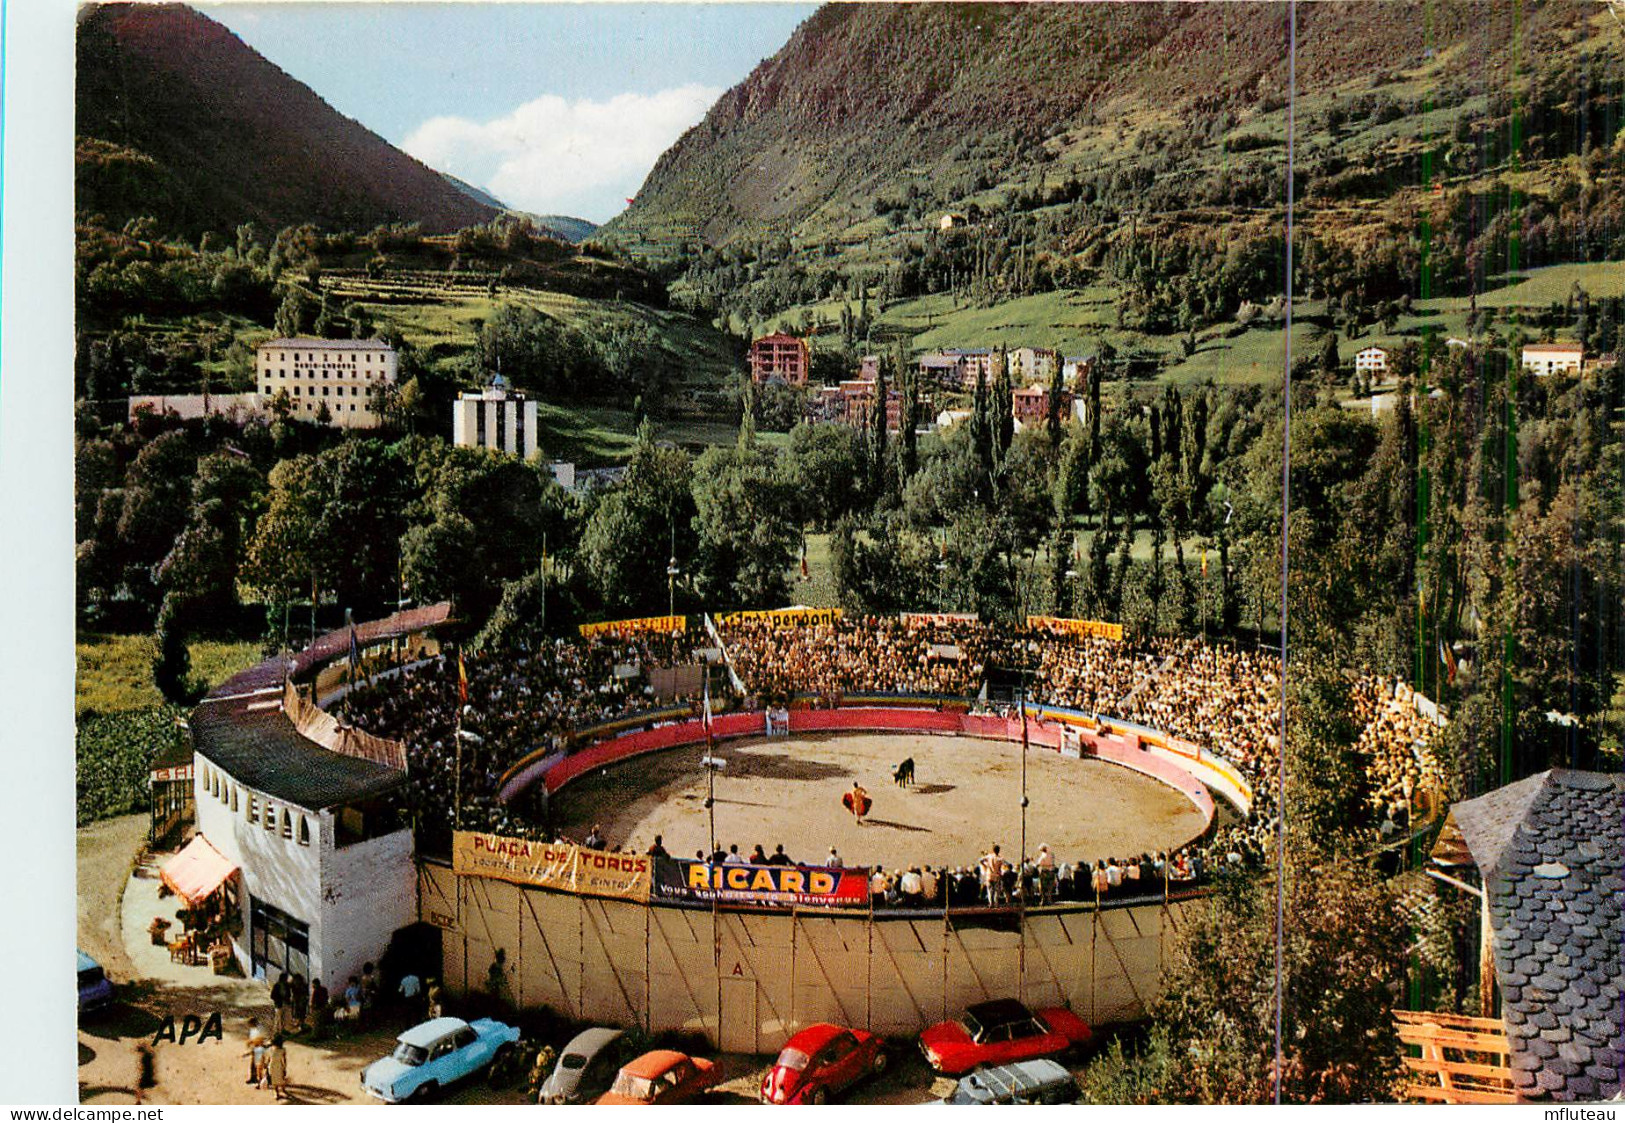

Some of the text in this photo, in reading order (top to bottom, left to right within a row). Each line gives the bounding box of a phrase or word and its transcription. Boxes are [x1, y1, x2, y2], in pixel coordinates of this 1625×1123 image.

[544, 850, 568, 864] DE
[579, 852, 647, 874] TOROS
[688, 862, 836, 894] RICARD
[660, 884, 688, 896] Vous
[732, 962, 744, 976] A
